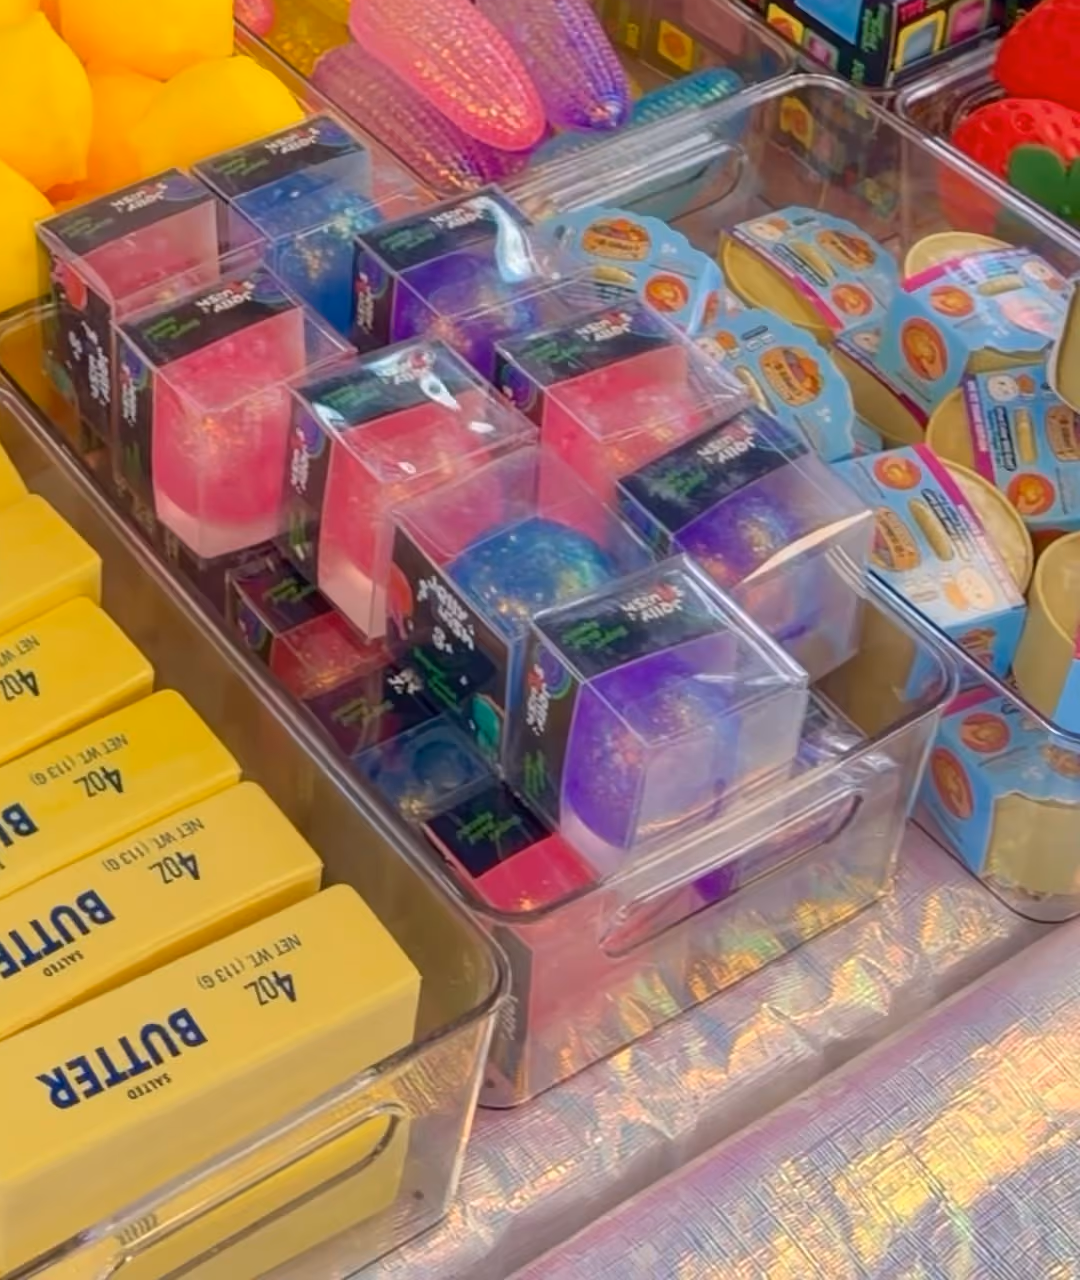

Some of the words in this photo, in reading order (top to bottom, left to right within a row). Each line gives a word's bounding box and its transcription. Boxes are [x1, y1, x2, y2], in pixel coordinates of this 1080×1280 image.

[14, 634, 41, 656] NET
[99, 733, 129, 753] NET
[175, 817, 205, 839] NET
[119, 841, 151, 865] (113
[272, 933, 303, 957] NET
[42, 949, 86, 978] SALTED
[215, 957, 246, 983] (113
[195, 974, 216, 991] G)
[34, 1007, 209, 1109] BUTTER
[126, 1072, 173, 1101] SALTED
